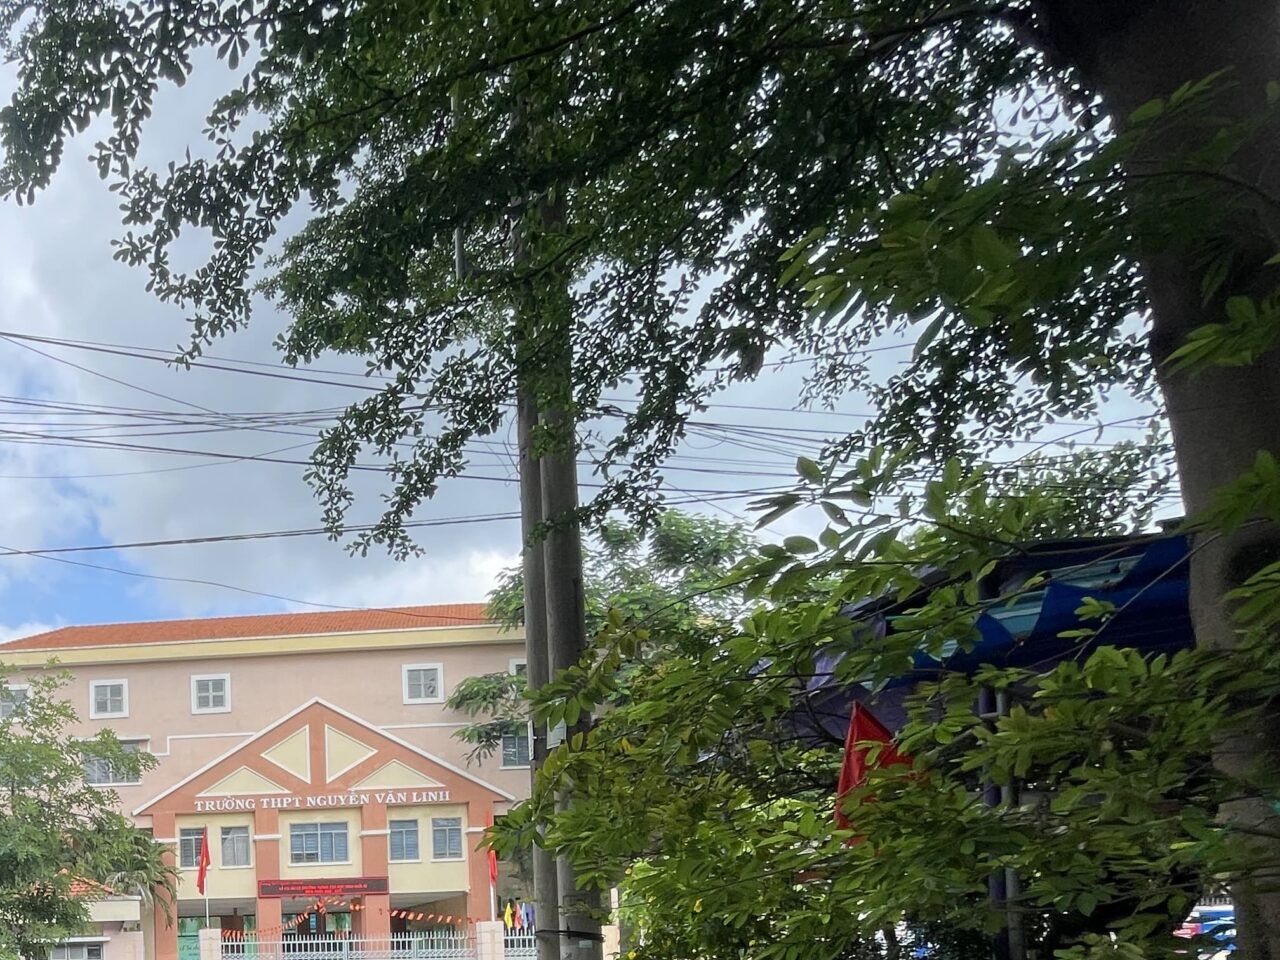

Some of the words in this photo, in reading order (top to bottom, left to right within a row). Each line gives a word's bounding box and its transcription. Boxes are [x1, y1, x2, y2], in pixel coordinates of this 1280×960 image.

[260, 797, 302, 809] THPT
[375, 790, 407, 804] VĂN
[412, 791, 450, 803] LINH
